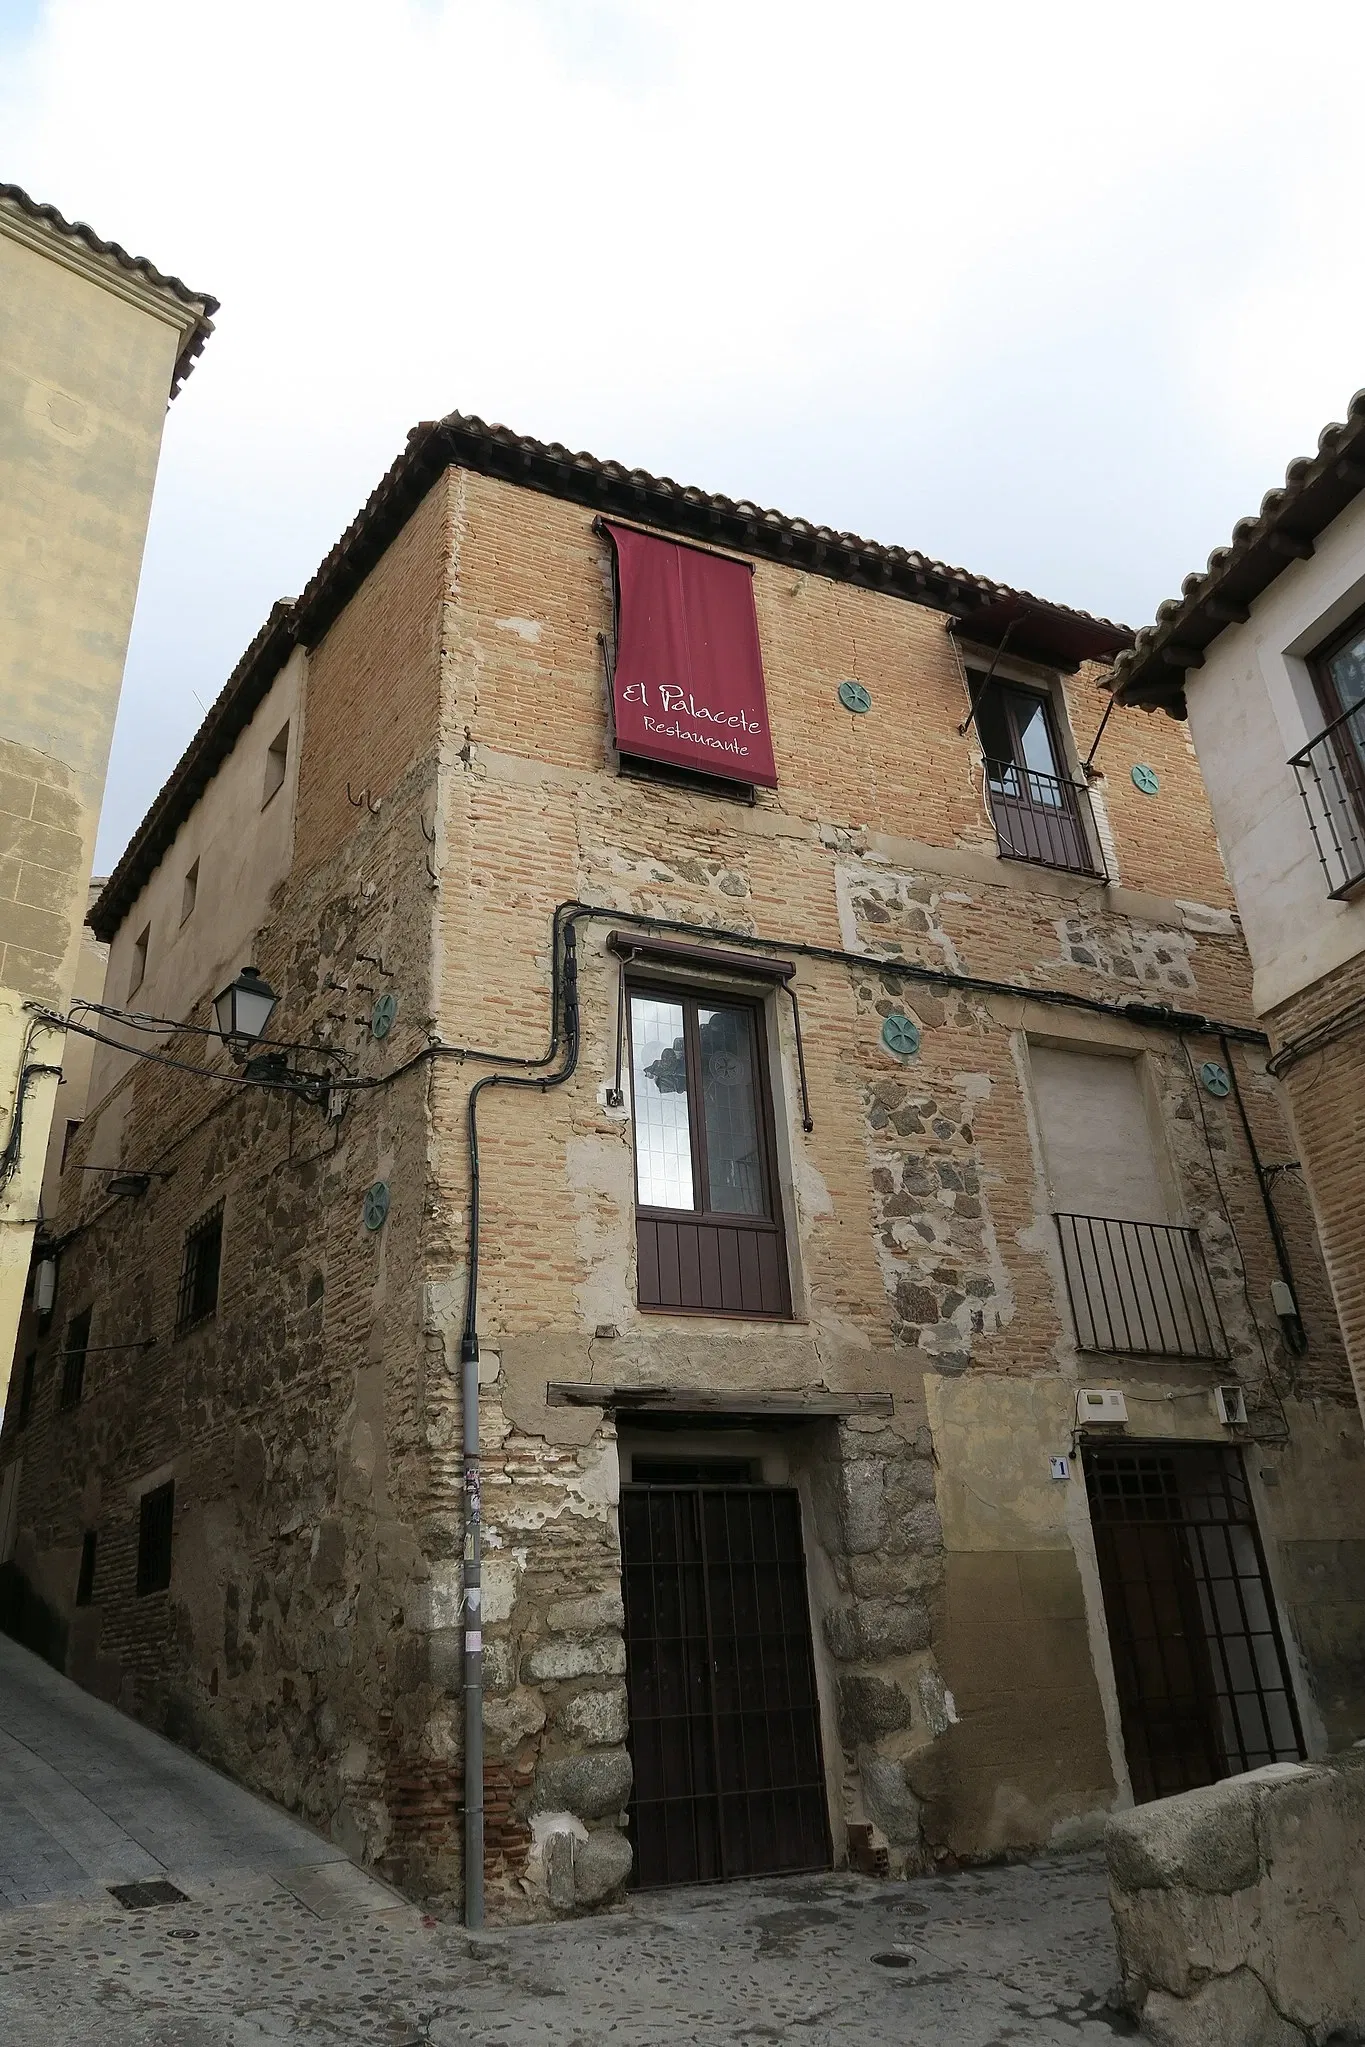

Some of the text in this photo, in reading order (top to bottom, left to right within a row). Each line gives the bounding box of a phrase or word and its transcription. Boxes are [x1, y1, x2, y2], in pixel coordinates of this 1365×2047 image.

[623, 682, 762, 734] El Palacete
[643, 715, 750, 756] Restaurante
[1058, 1461, 1066, 1475] 1
